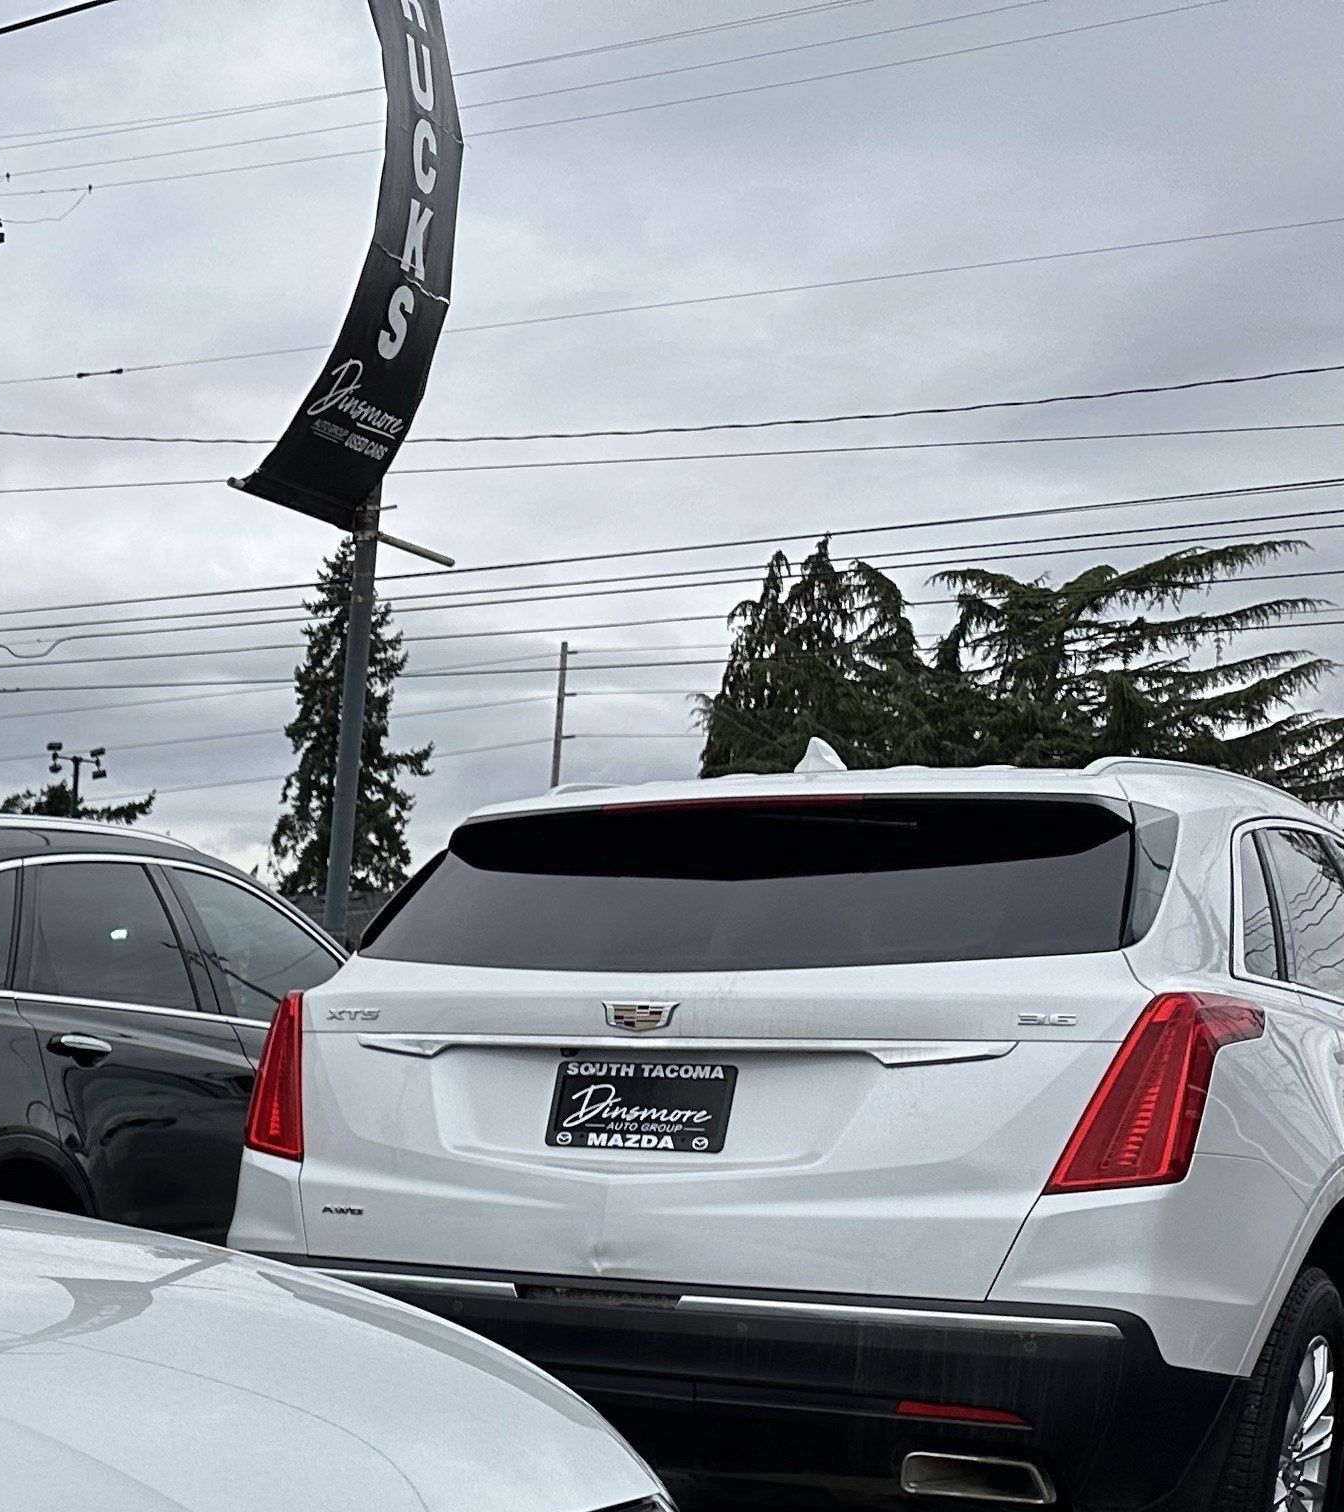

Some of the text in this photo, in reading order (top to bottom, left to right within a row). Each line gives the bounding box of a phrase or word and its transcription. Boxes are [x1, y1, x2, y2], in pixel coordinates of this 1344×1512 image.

[566, 1062, 725, 1080] SOUTH TACOMA
[562, 1083, 712, 1128] Dinsmore
[606, 1121, 683, 1133] AUTO GROUP
[586, 1132, 675, 1150] MAZDA
